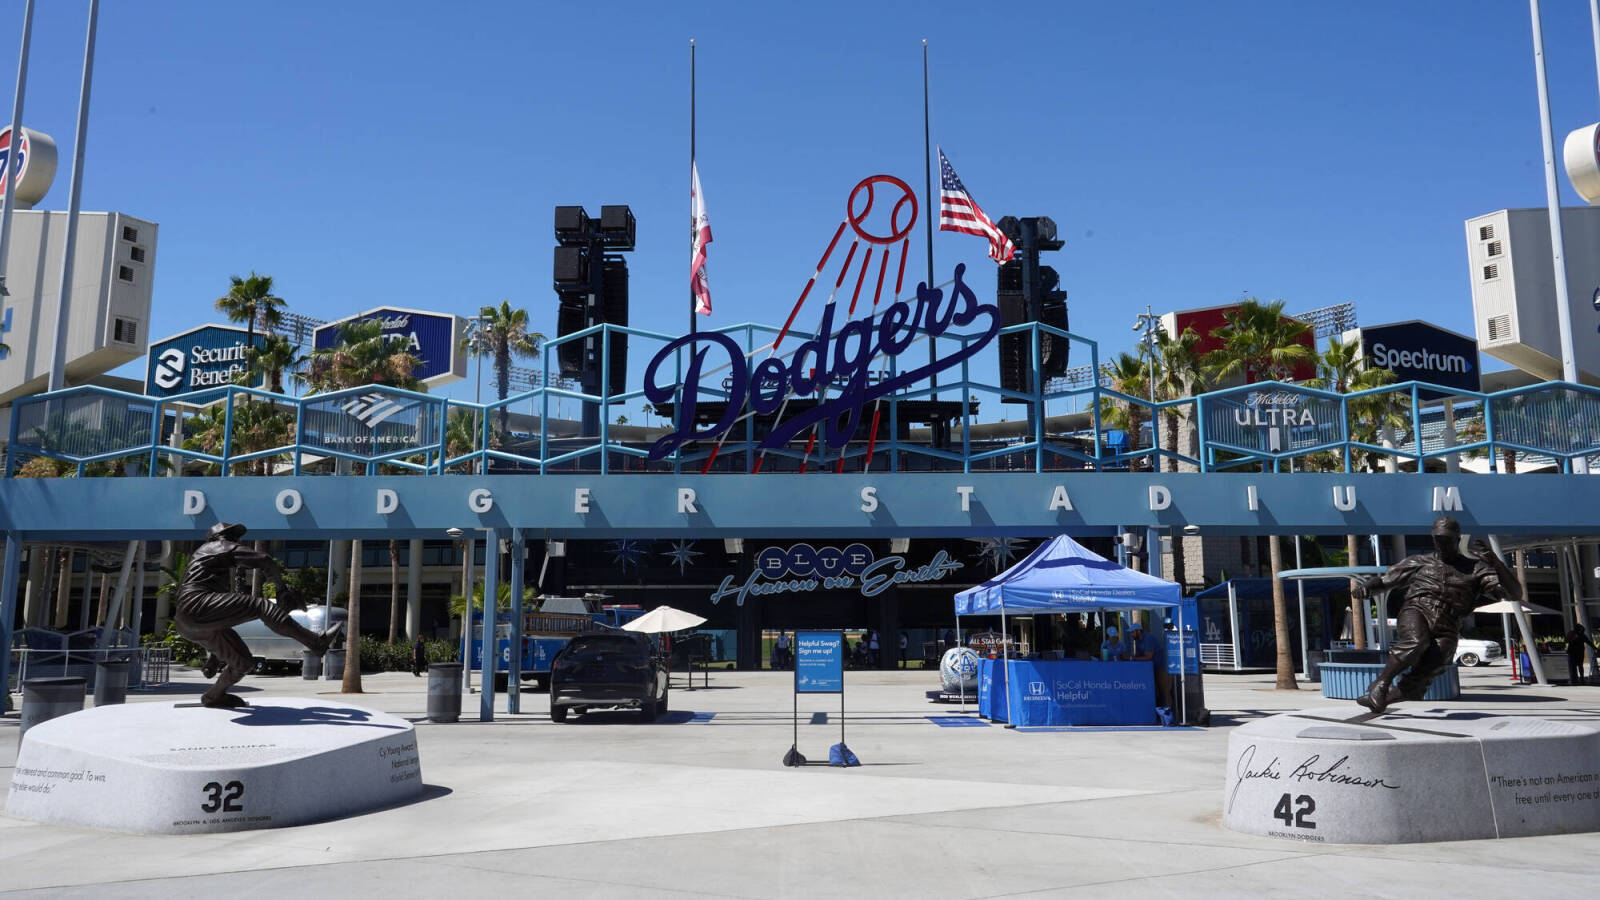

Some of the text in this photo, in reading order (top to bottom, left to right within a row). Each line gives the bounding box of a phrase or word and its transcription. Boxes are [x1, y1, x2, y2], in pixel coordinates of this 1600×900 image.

[644, 263, 999, 461] Dodgers
[1373, 343, 1466, 373] Spectrum
[1246, 391, 1299, 406] Michelob
[1235, 408, 1315, 425] ULTRA
[324, 435, 416, 444] BANK OF AMERICA
[184, 486, 1464, 514] DODGER STADIUM
[711, 550, 954, 606] Heaven on Earth
[1204, 617, 1220, 640] LA
[799, 640, 840, 648] Helpful Swag?
[1056, 680, 1146, 690] SoCal Honda Dealers
[1057, 691, 1089, 702] Helpful
[1228, 744, 1401, 814] Jackie Robinson
[1530, 776, 1542, 786] not
[1544, 777, 1555, 785] an
[1556, 773, 1593, 783] American
[201, 780, 245, 814] 32
[1515, 792, 1532, 805] free
[1534, 791, 1551, 804] until
[1553, 793, 1575, 805] every
[1577, 792, 1592, 801] one
[1273, 792, 1317, 830] 42
[1268, 831, 1325, 842] BROOKLYN DODGERS
